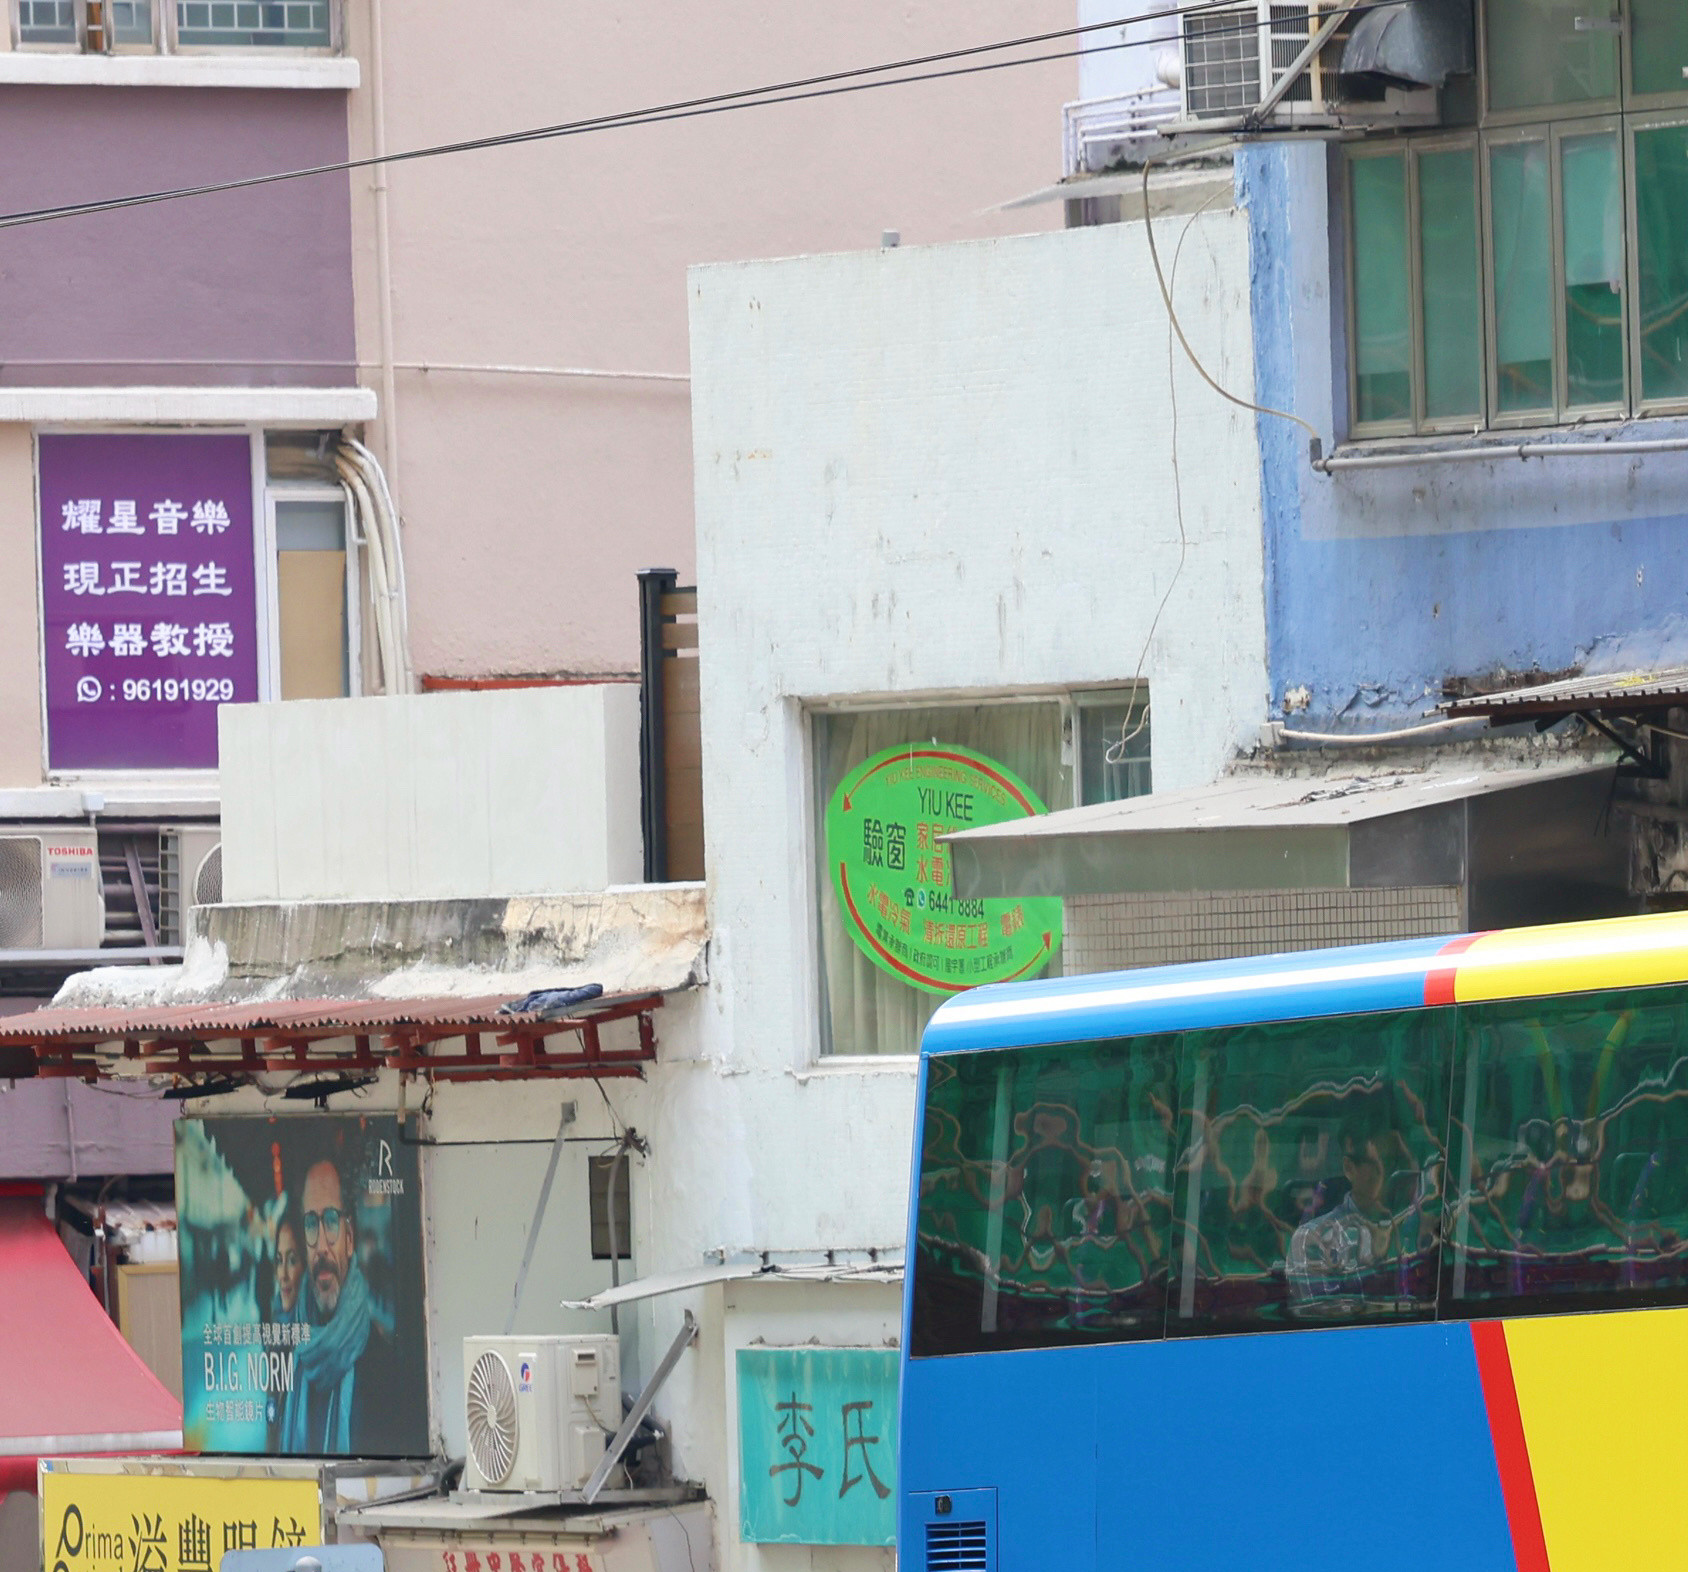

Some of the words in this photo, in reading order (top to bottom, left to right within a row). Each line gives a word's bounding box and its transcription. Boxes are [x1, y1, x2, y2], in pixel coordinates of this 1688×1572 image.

[62, 499, 230, 535] 耀星音樂
[63, 561, 232, 596] 現正招生
[65, 622, 234, 658] 樂器教授
[918, 787, 942, 816] YIU
[946, 793, 974, 821] KEE
[916, 857, 952, 886] 水電
[368, 1178, 404, 1195] RODENSTOCK
[247, 1351, 294, 1392] NORM
